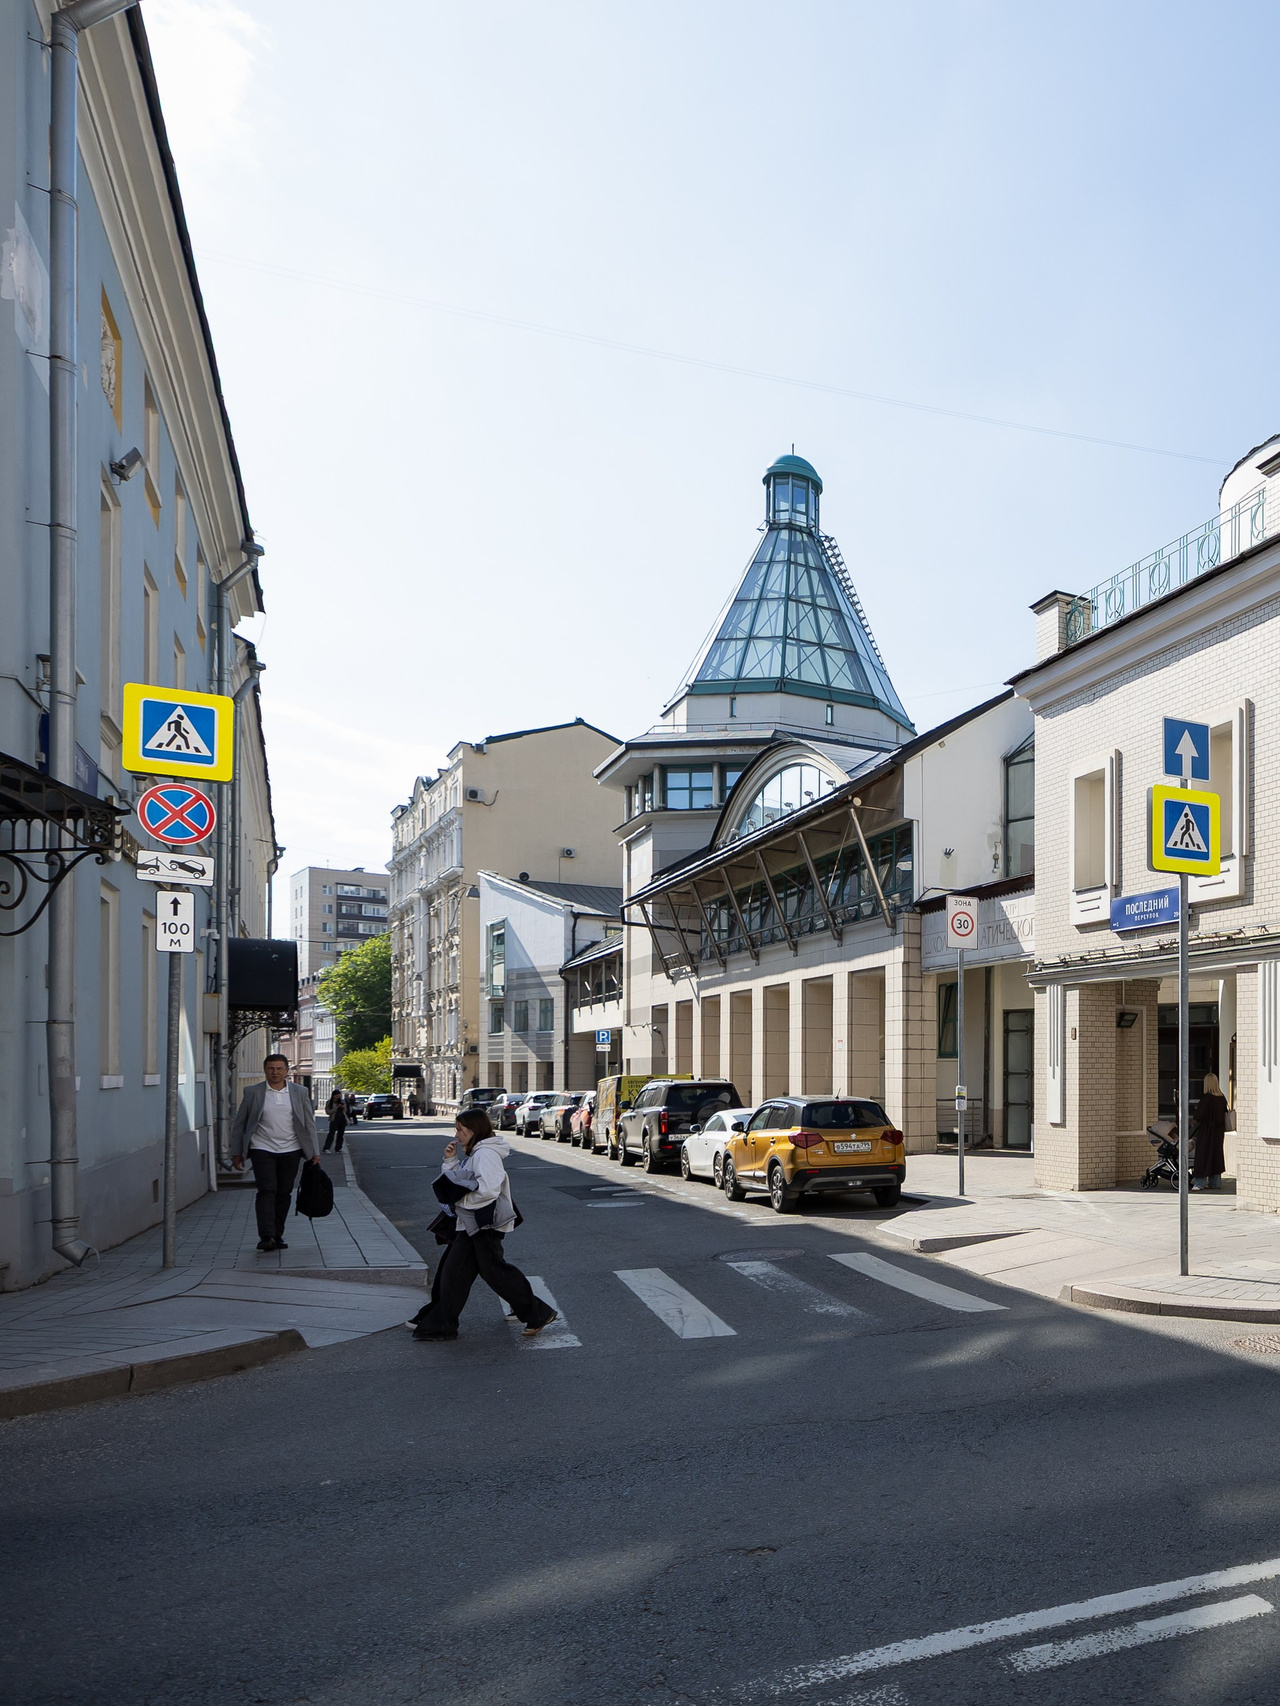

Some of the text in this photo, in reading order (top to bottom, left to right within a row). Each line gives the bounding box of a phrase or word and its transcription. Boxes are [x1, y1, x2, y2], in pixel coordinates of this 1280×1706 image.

[1125, 895, 1169, 916] ПОСЛЕДНИЙ
[1134, 912, 1159, 921] ПЕРЕУЛОК
[161, 922, 190, 935] 100
[956, 919, 969, 930] 30
[980, 917, 1035, 945] АТИЧЕСКОГ
[169, 938, 182, 948] М
[599, 1031, 608, 1042] P
